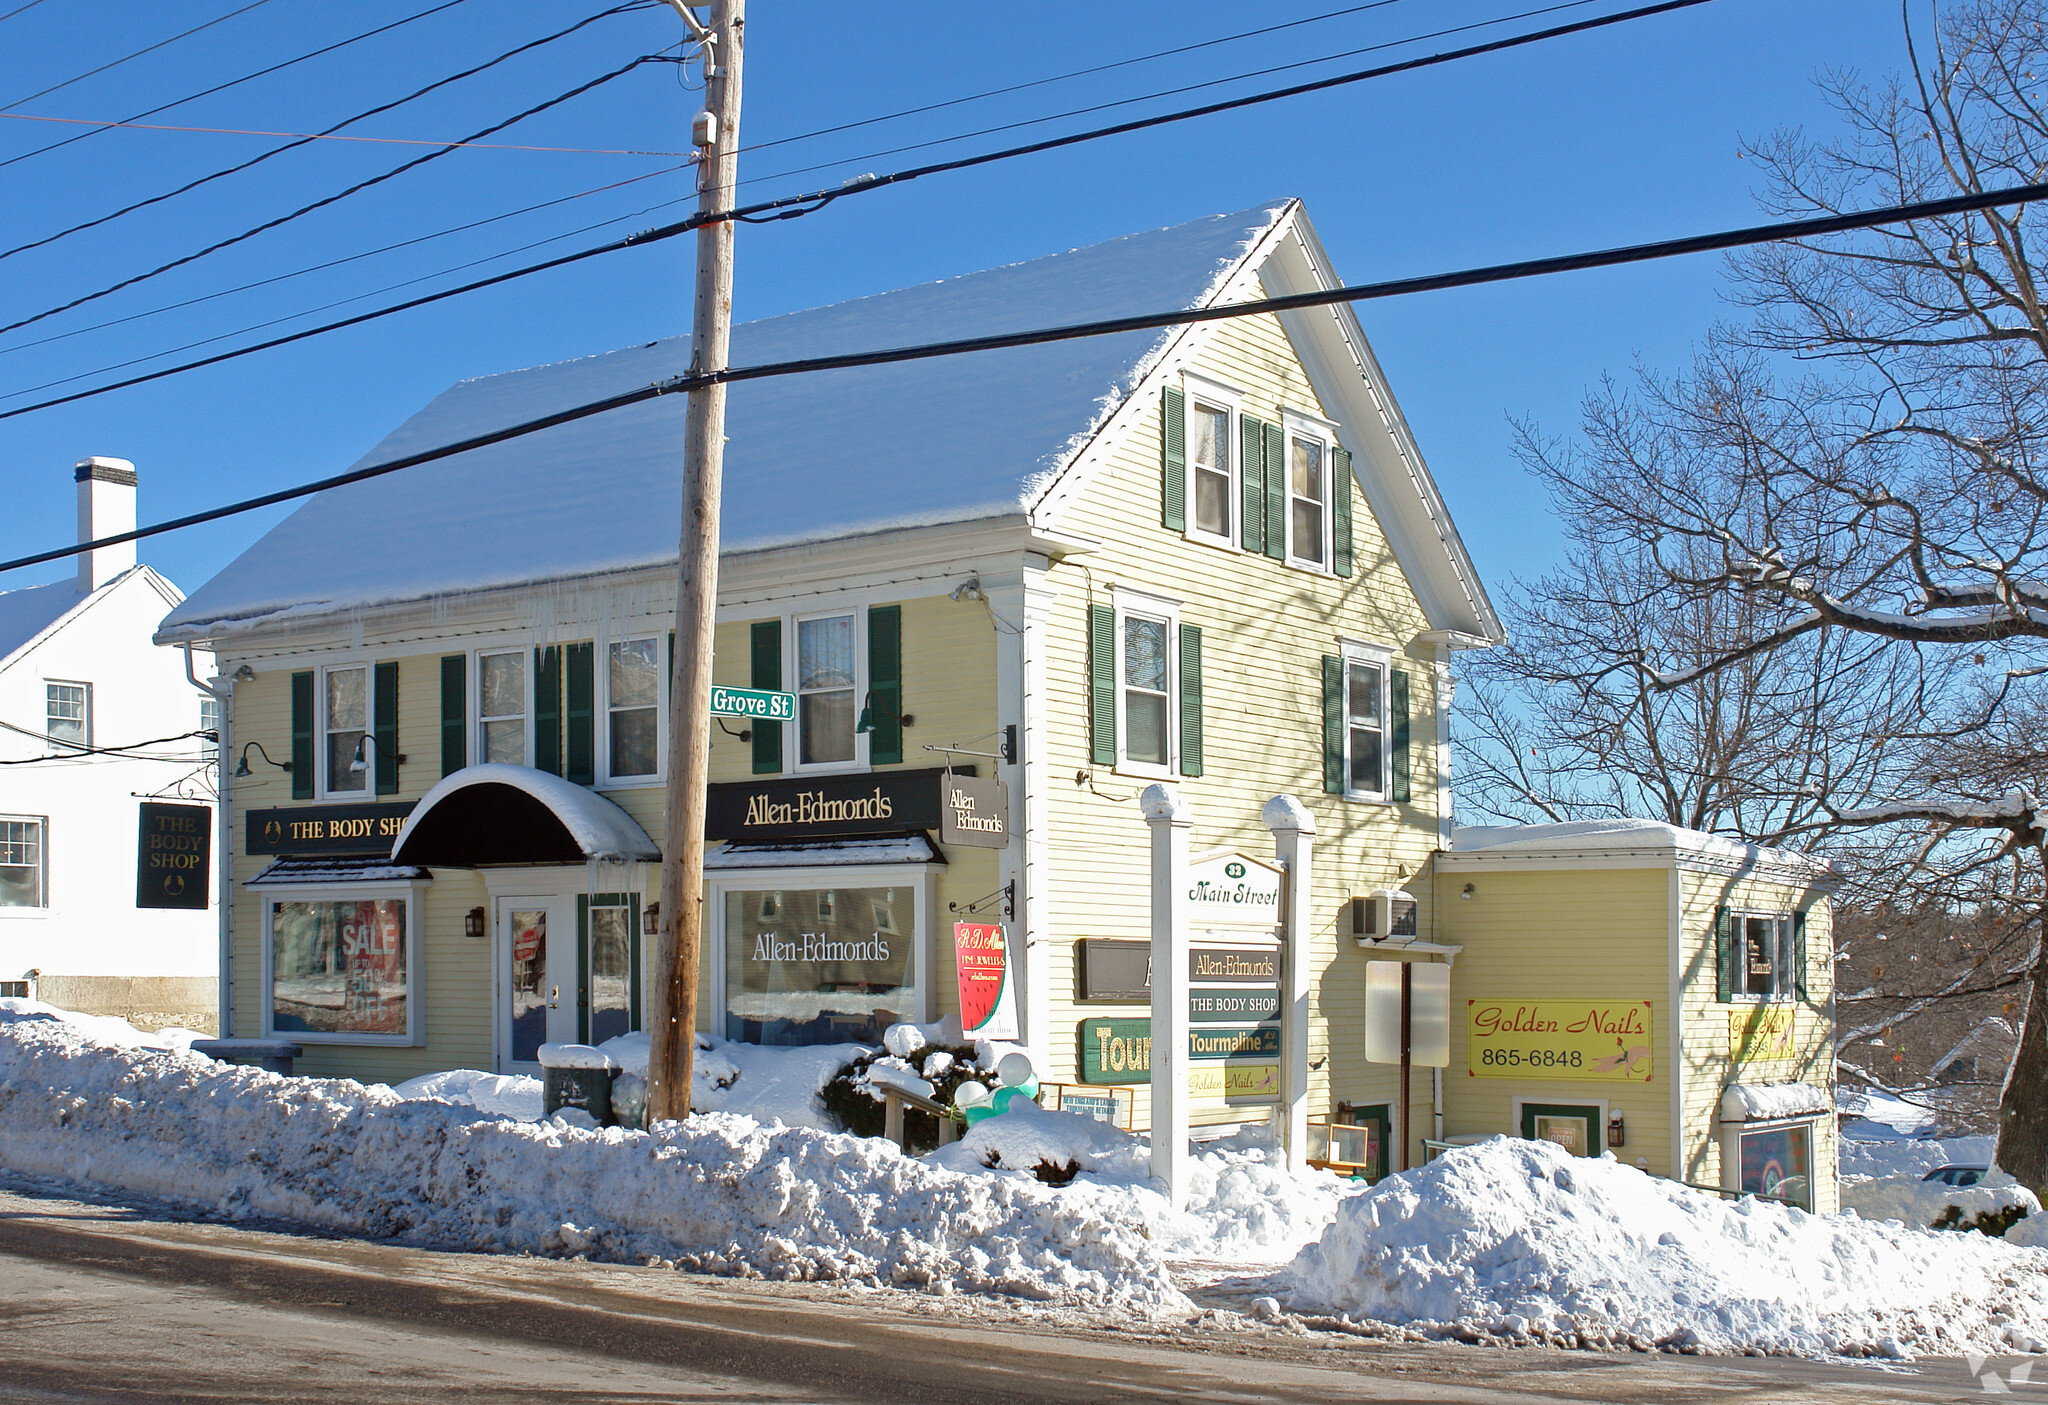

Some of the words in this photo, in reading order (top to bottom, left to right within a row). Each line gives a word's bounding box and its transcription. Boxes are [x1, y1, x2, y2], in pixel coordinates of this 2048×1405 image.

[713, 689, 767, 715] Grove
[770, 694, 789, 717] St
[744, 787, 892, 825] Allen-Edmonds
[949, 788, 976, 811] Allen
[156, 815, 197, 833] THE
[290, 821, 325, 839] THE
[329, 818, 374, 838] BODY
[379, 817, 408, 836] SH
[955, 809, 1003, 833] Edmonds
[149, 833, 203, 851] BODY
[150, 852, 200, 869] SHOP
[1228, 864, 1242, 876] 32
[1189, 881, 1230, 903] Main
[1233, 883, 1277, 905] Street
[342, 924, 396, 955] SALE
[752, 930, 890, 963] Allen-Edmonds
[1195, 954, 1274, 976] Allen-Edmonds
[1190, 997, 1213, 1011] THE
[1215, 997, 1247, 1011] BODY
[1249, 997, 1277, 1012] SHOP
[1475, 1007, 1559, 1037] Golden
[1565, 1008, 1645, 1034] Nails
[1096, 1026, 1152, 1072] Tour
[1189, 1031, 1262, 1053] Tourmaline
[1482, 1048, 1583, 1068] 865-6848
[1188, 1073, 1222, 1094] Golden
[1225, 1072, 1253, 1089] Nails
